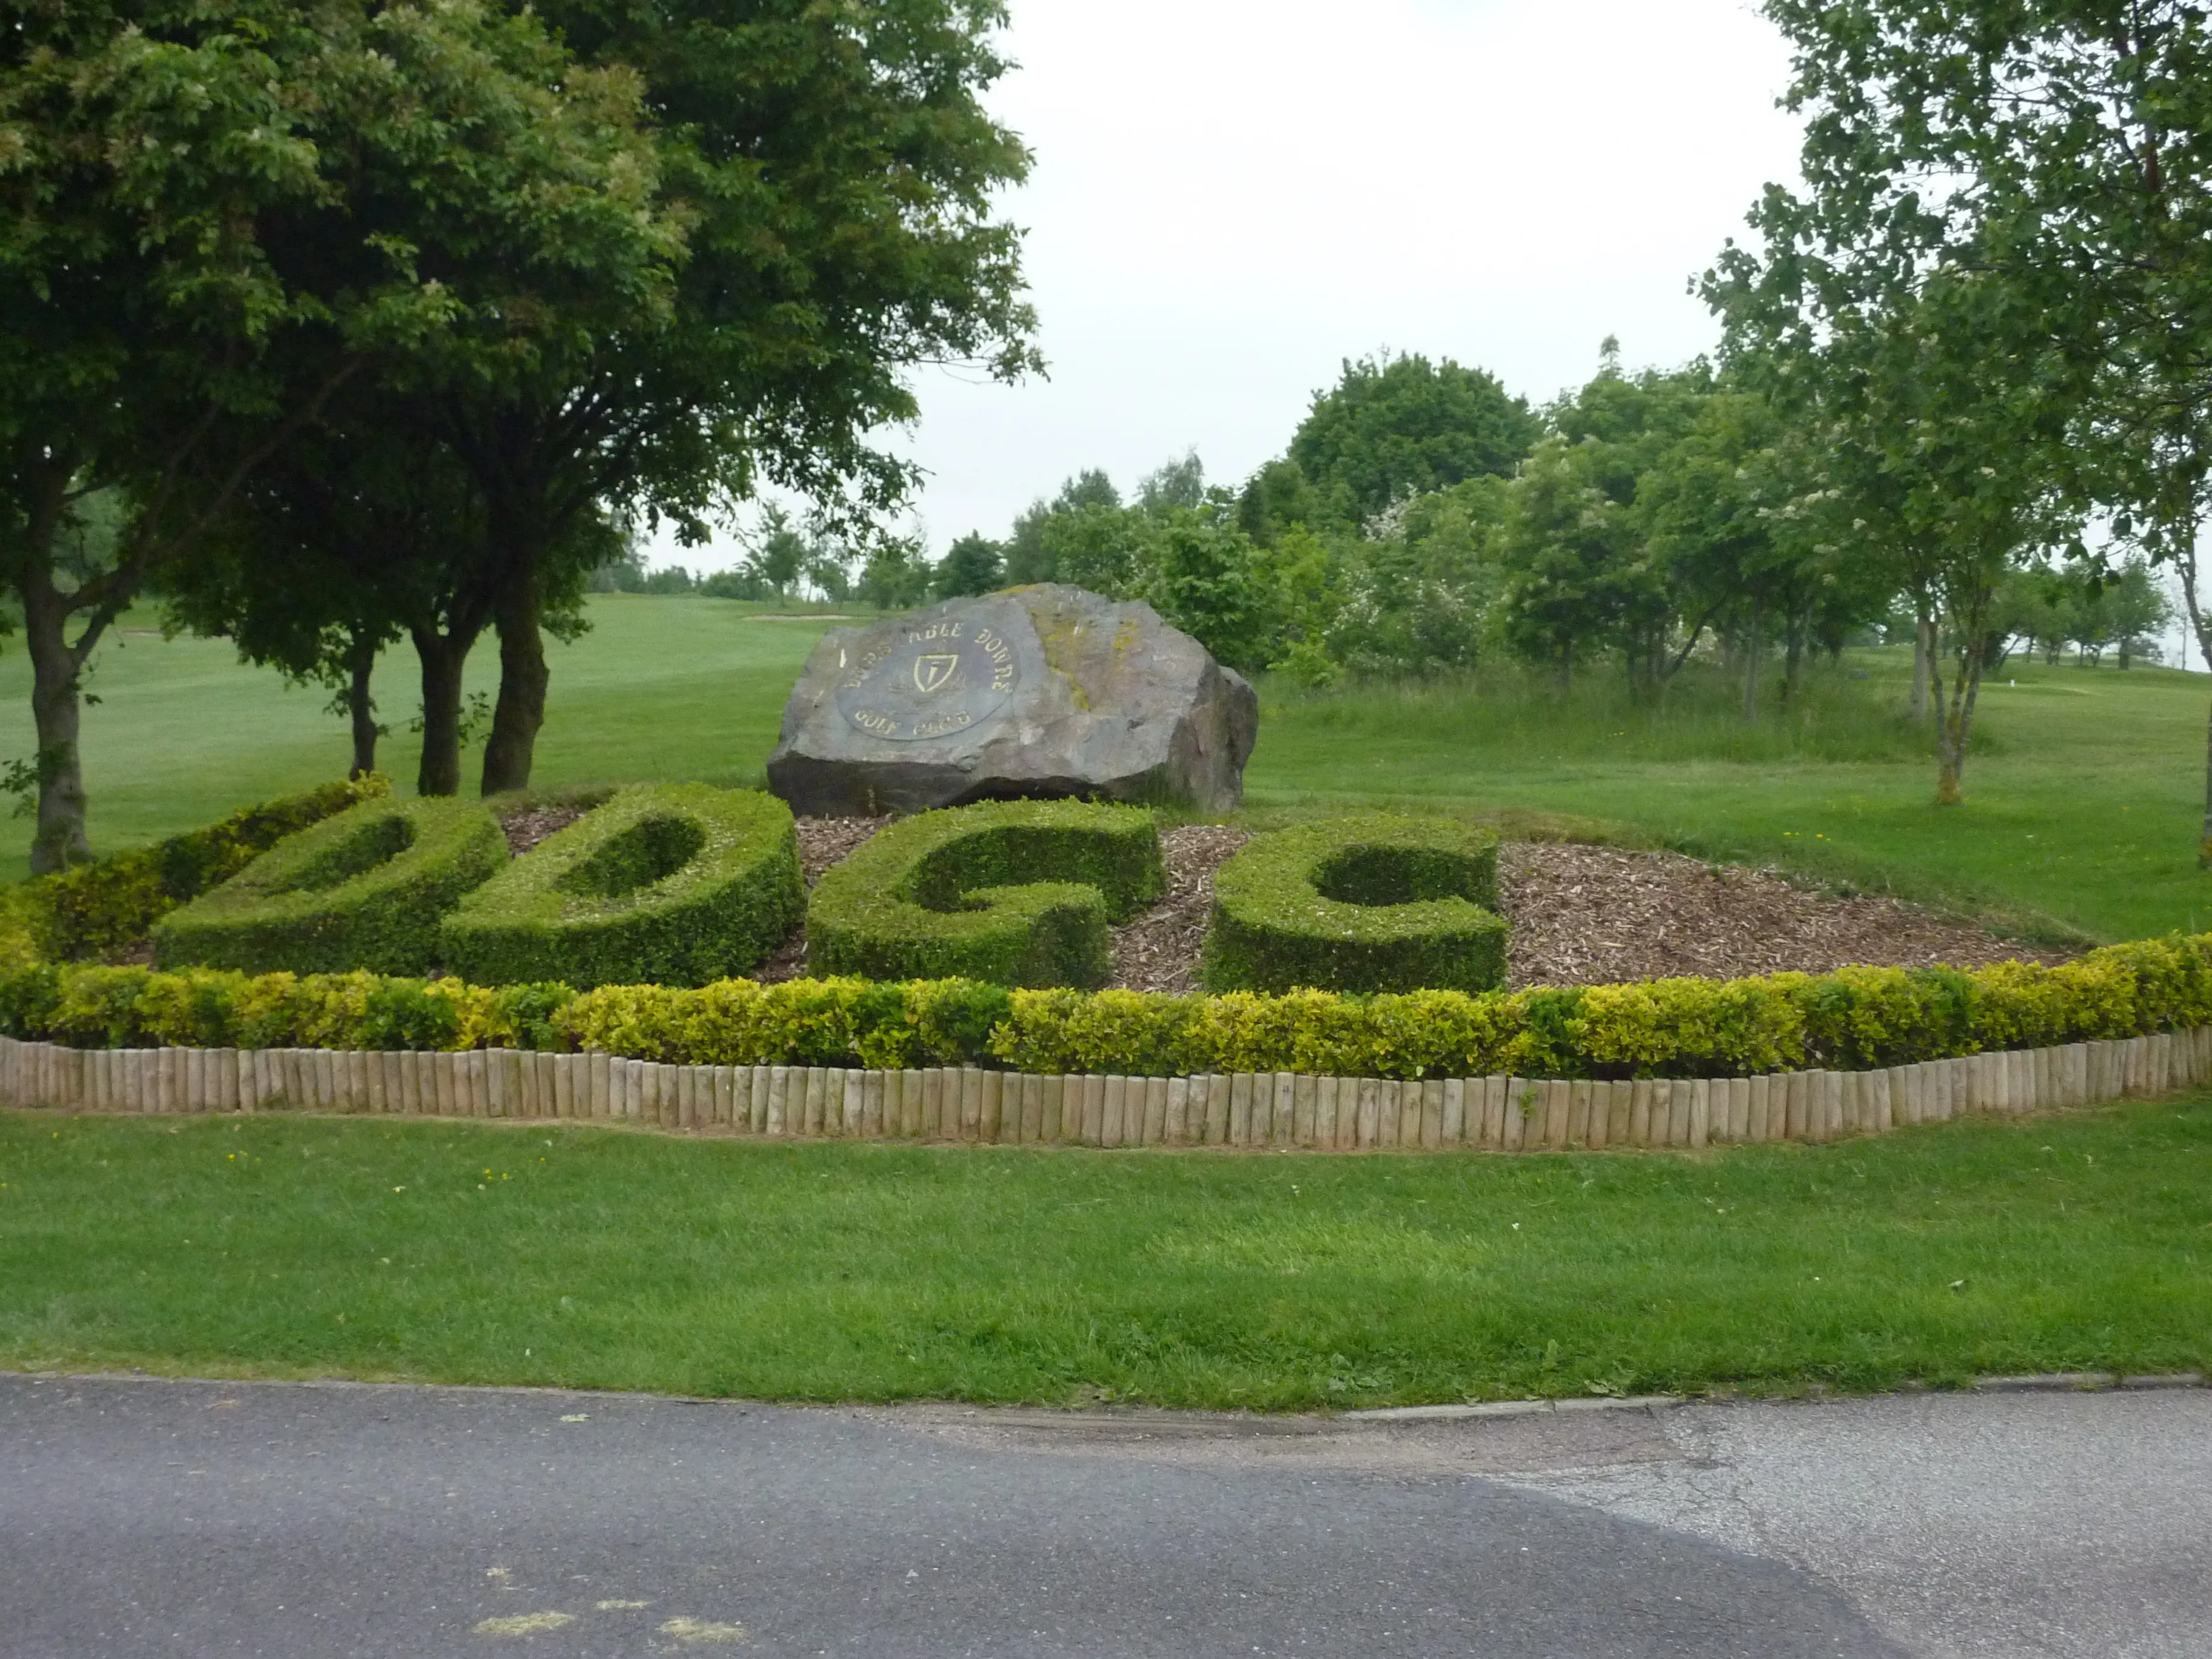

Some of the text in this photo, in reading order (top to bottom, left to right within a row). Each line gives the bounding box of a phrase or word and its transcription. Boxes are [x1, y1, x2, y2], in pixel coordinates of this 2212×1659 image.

[843, 622, 1013, 693] DABLE DOWNS
[854, 709, 901, 735] GOLF
